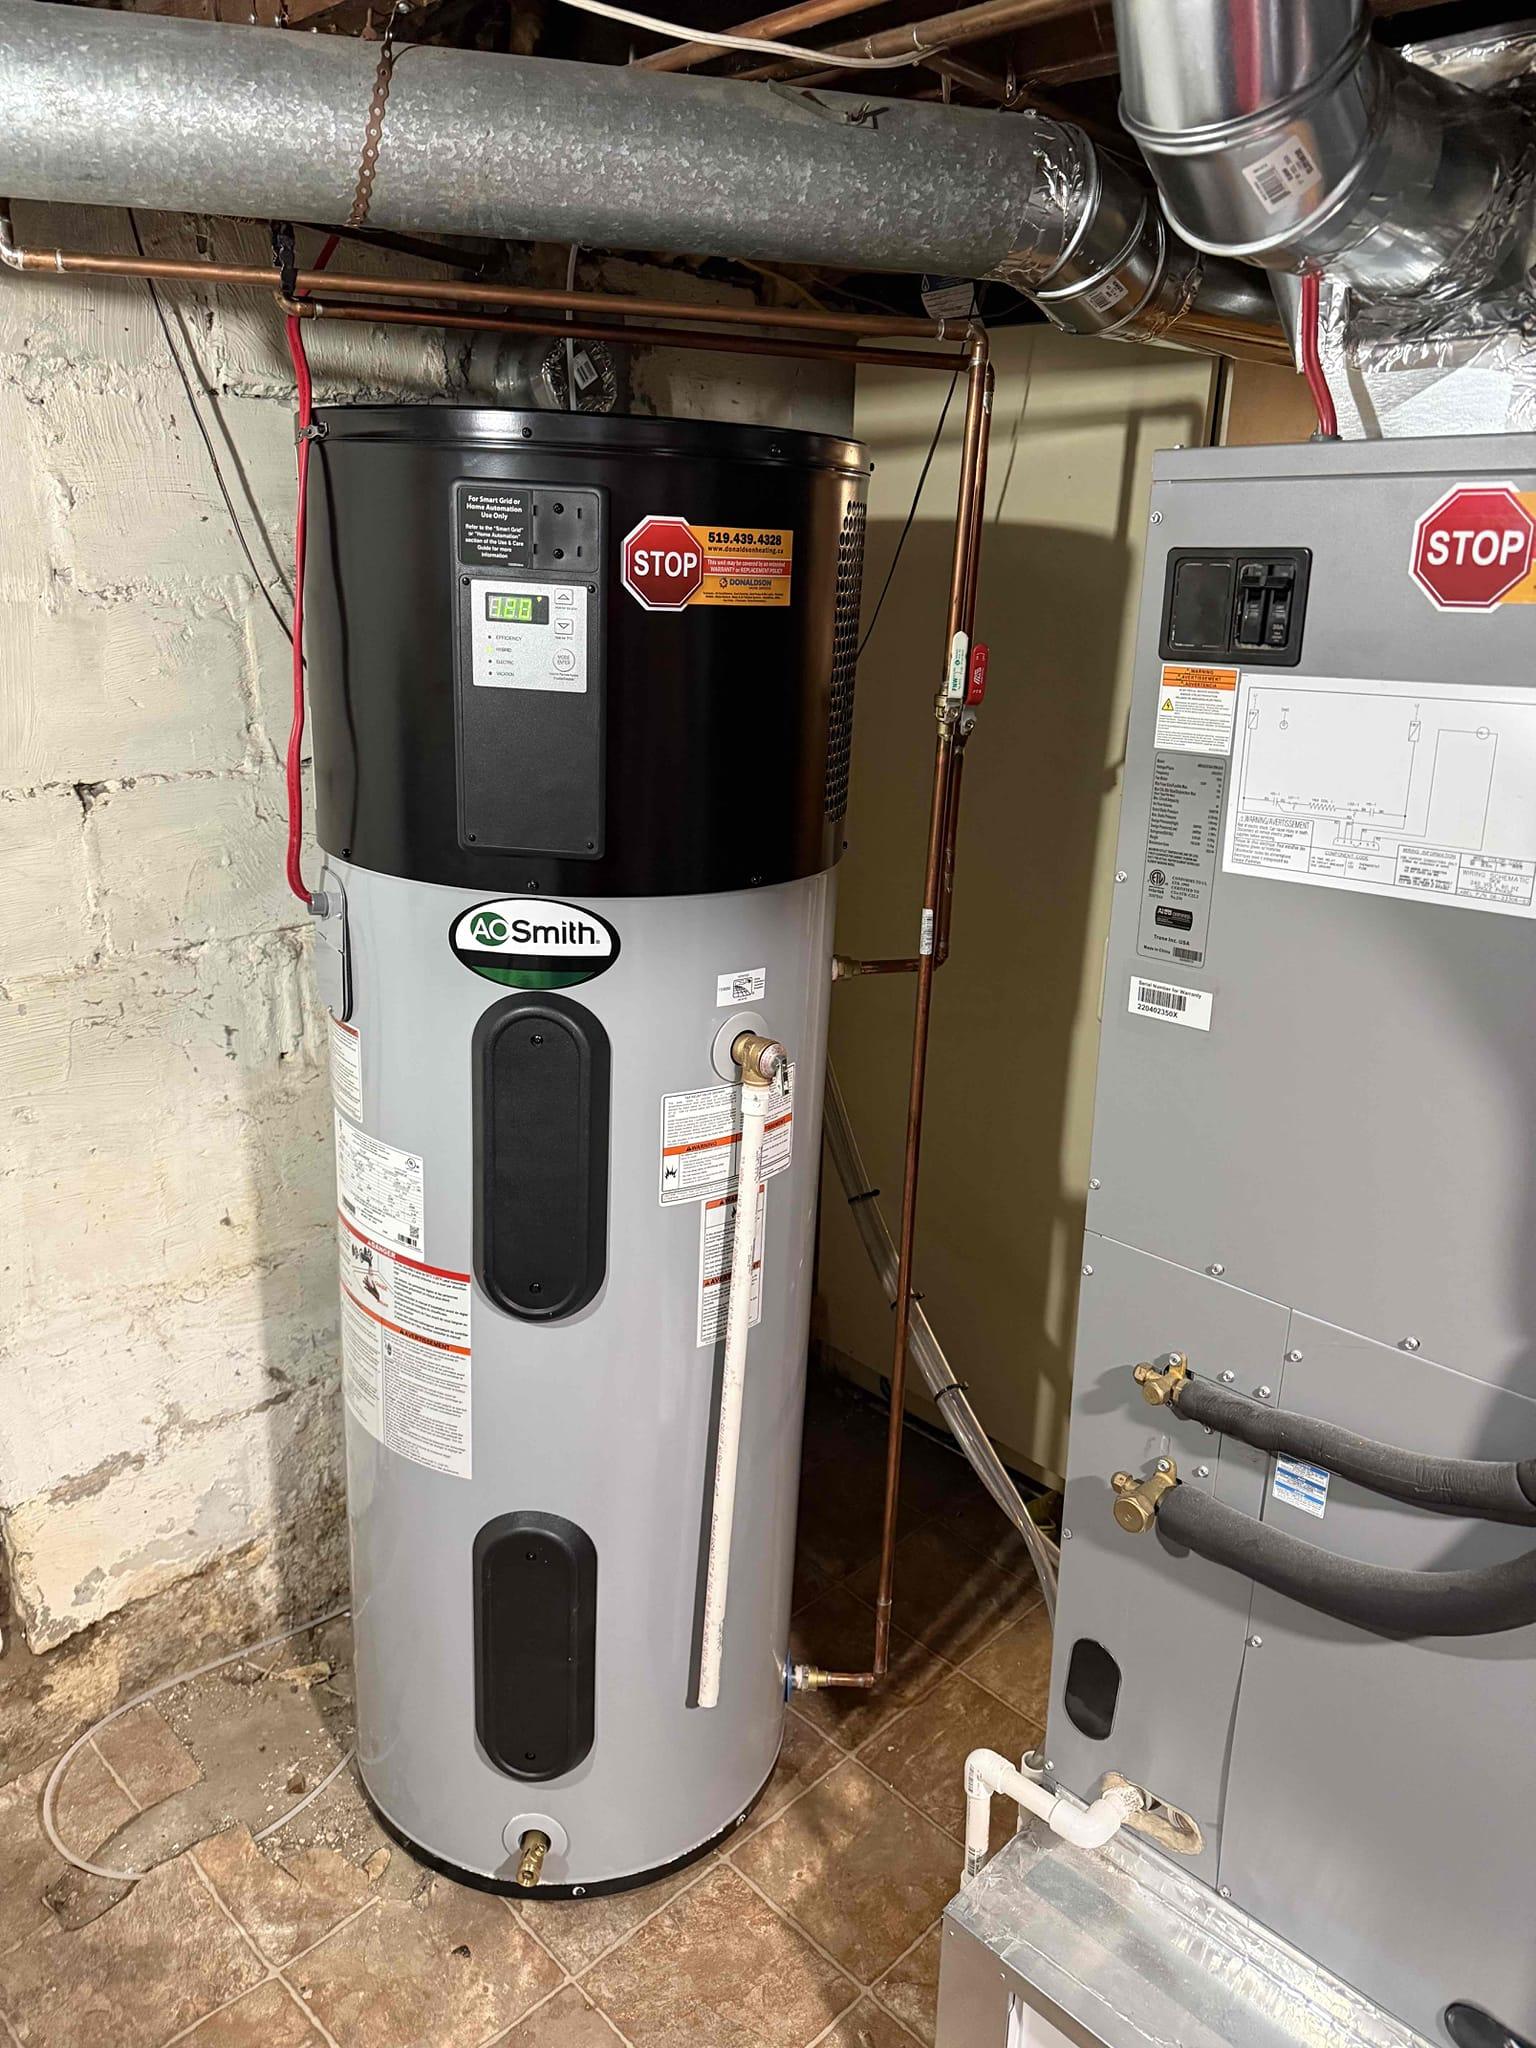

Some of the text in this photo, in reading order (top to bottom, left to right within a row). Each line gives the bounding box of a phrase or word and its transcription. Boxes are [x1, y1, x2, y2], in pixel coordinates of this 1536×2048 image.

[486, 504, 522, 513] Automation
[493, 512, 508, 520] Only
[708, 532, 782, 546] 519.439.4328
[708, 546, 784, 554] www.donaldsonheating.ca
[1427, 530, 1524, 566] STOP
[634, 550, 698, 578] STOP
[730, 578, 772, 587] DONALDSON
[1490, 874, 1529, 883] SCHEMATIC
[1180, 990, 1201, 999] Warranty
[1137, 1003, 1178, 1018] 220402350X
